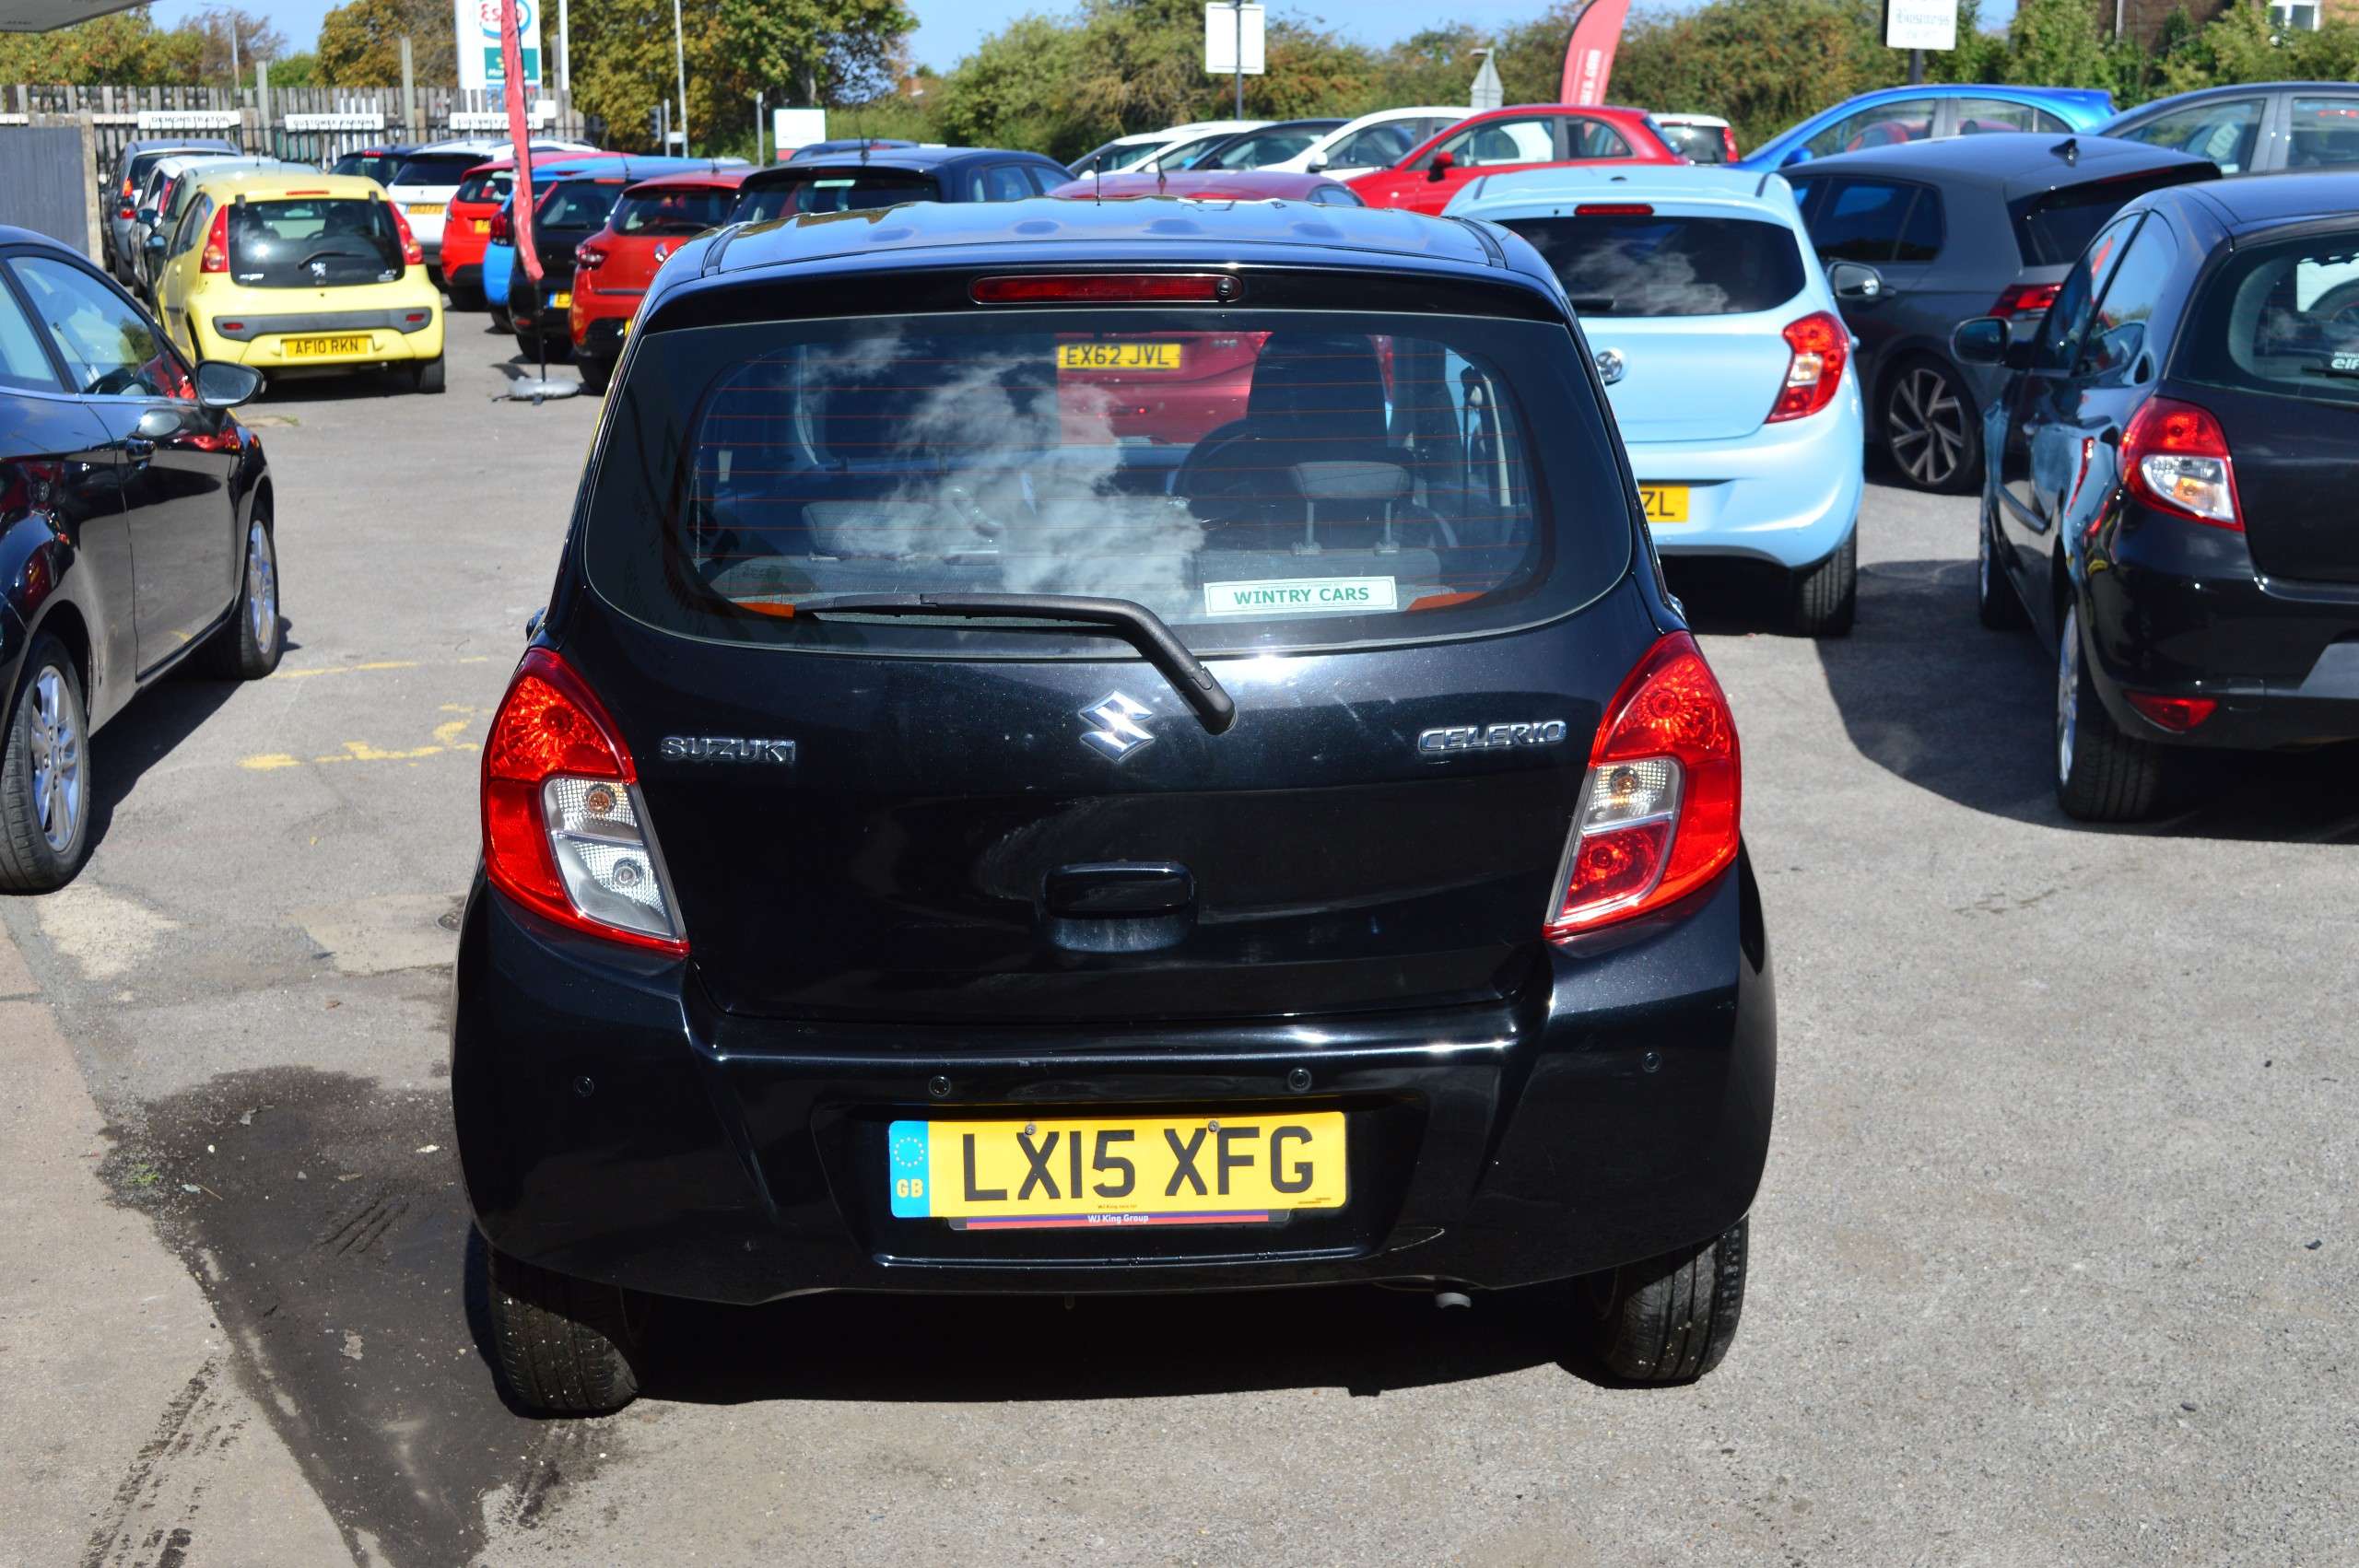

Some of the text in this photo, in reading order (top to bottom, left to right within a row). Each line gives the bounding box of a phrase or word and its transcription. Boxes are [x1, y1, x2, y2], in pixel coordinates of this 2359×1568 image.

[295, 338, 358, 355] AF10 RKN
[1066, 345, 1169, 366] EX62 JVL
[1234, 589, 1311, 605] WINTRY
[1320, 587, 1369, 602] CARS
[1419, 720, 1567, 753] CELERIO
[661, 737, 796, 762] SUZUKI
[963, 1125, 1314, 1201] LX15 XFG
[897, 1179, 923, 1198] GB
[1087, 1213, 1149, 1224] WJ King Group
